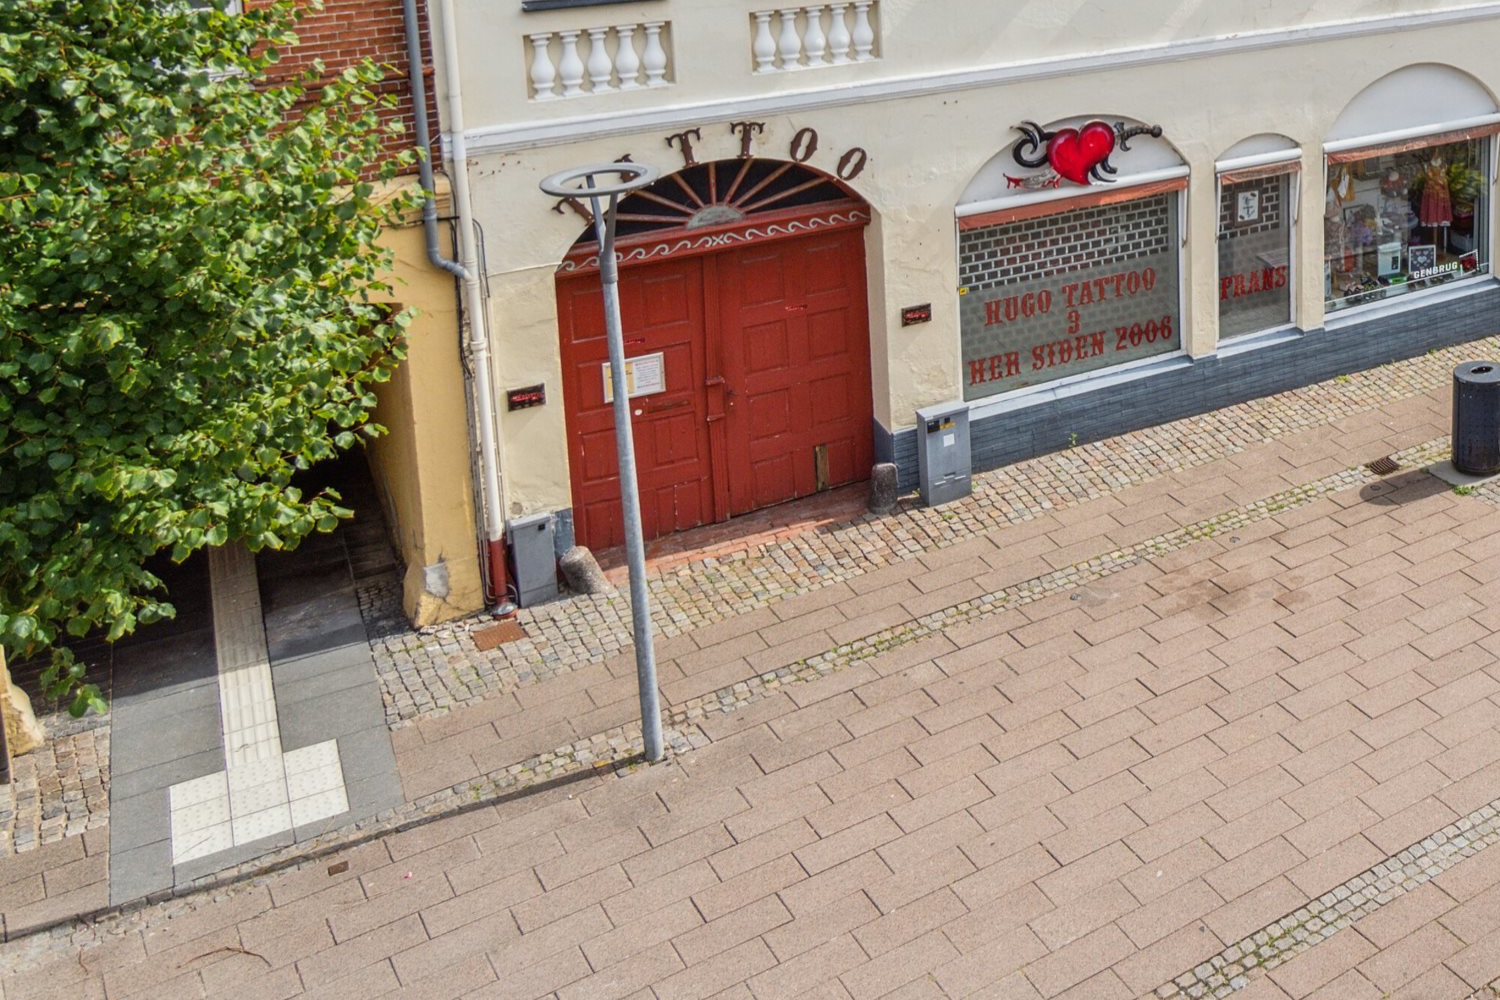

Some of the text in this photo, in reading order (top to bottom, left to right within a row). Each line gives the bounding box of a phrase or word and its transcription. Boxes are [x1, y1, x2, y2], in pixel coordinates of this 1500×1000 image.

[984, 267, 1156, 327] HUGO TATTOO
[1413, 261, 1458, 279] GENBRUG
[968, 315, 1173, 386] HER SIDEN 2006
